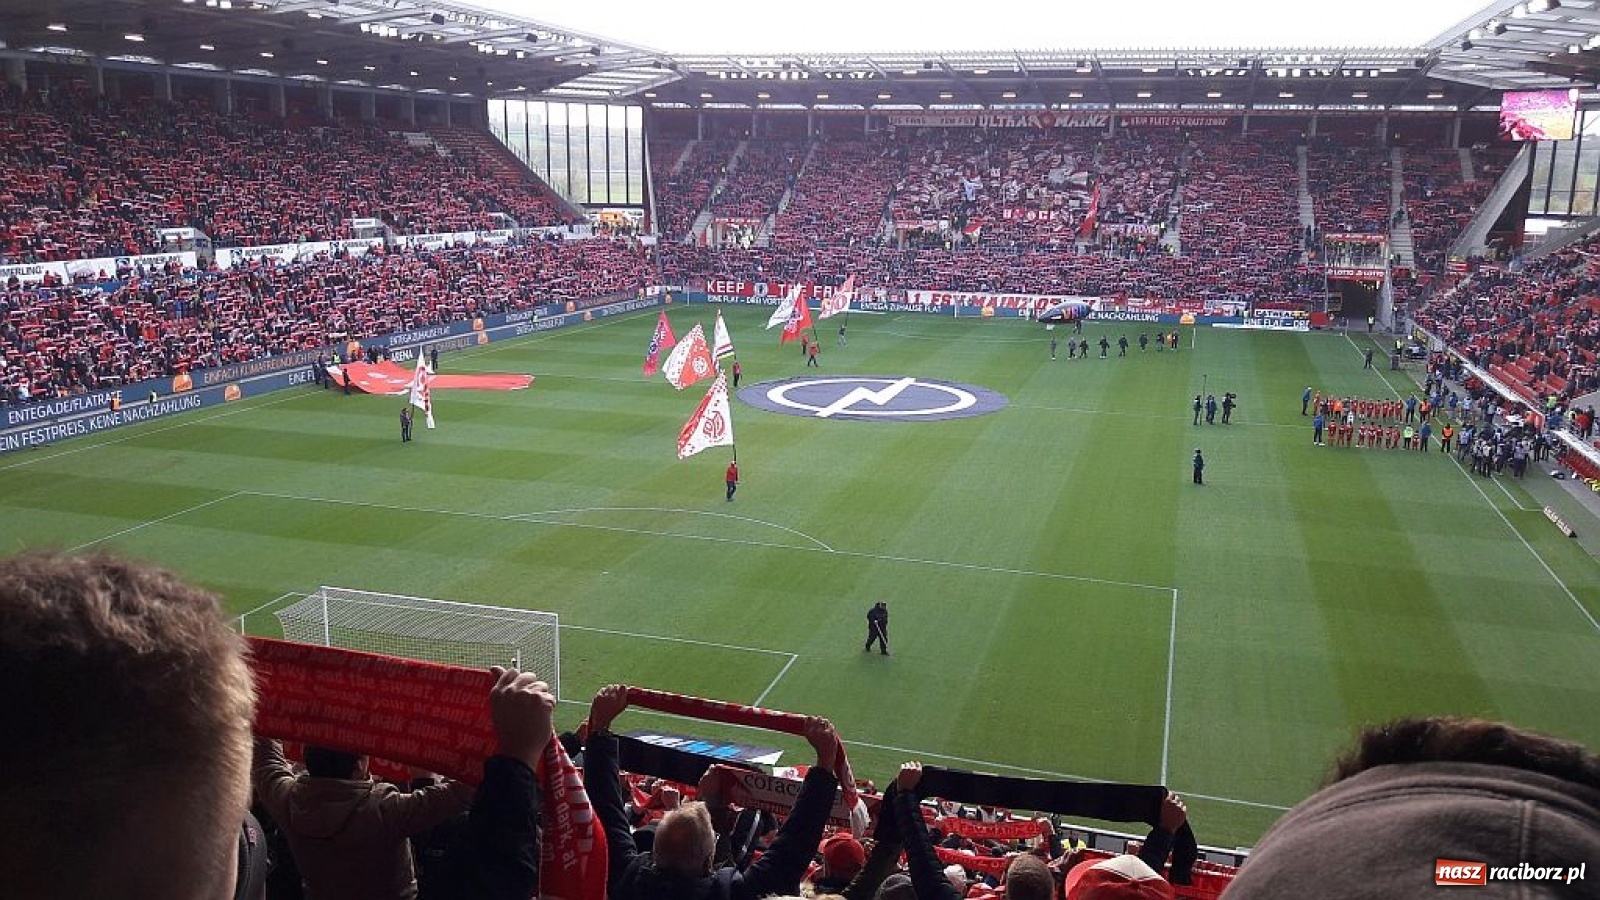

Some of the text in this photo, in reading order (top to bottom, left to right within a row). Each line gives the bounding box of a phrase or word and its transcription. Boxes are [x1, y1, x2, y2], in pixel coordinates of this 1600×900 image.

[706, 280, 745, 294] KEEP
[1098, 312, 1159, 322] NACHZAHLUNG
[8, 390, 123, 425] ENTEGA.DE/FLATRATE
[0, 394, 201, 451] EIN FESTPREIS, KEINE NACHZAHLUNG
[554, 802, 574, 849] dark,
[561, 849, 578, 870] at
